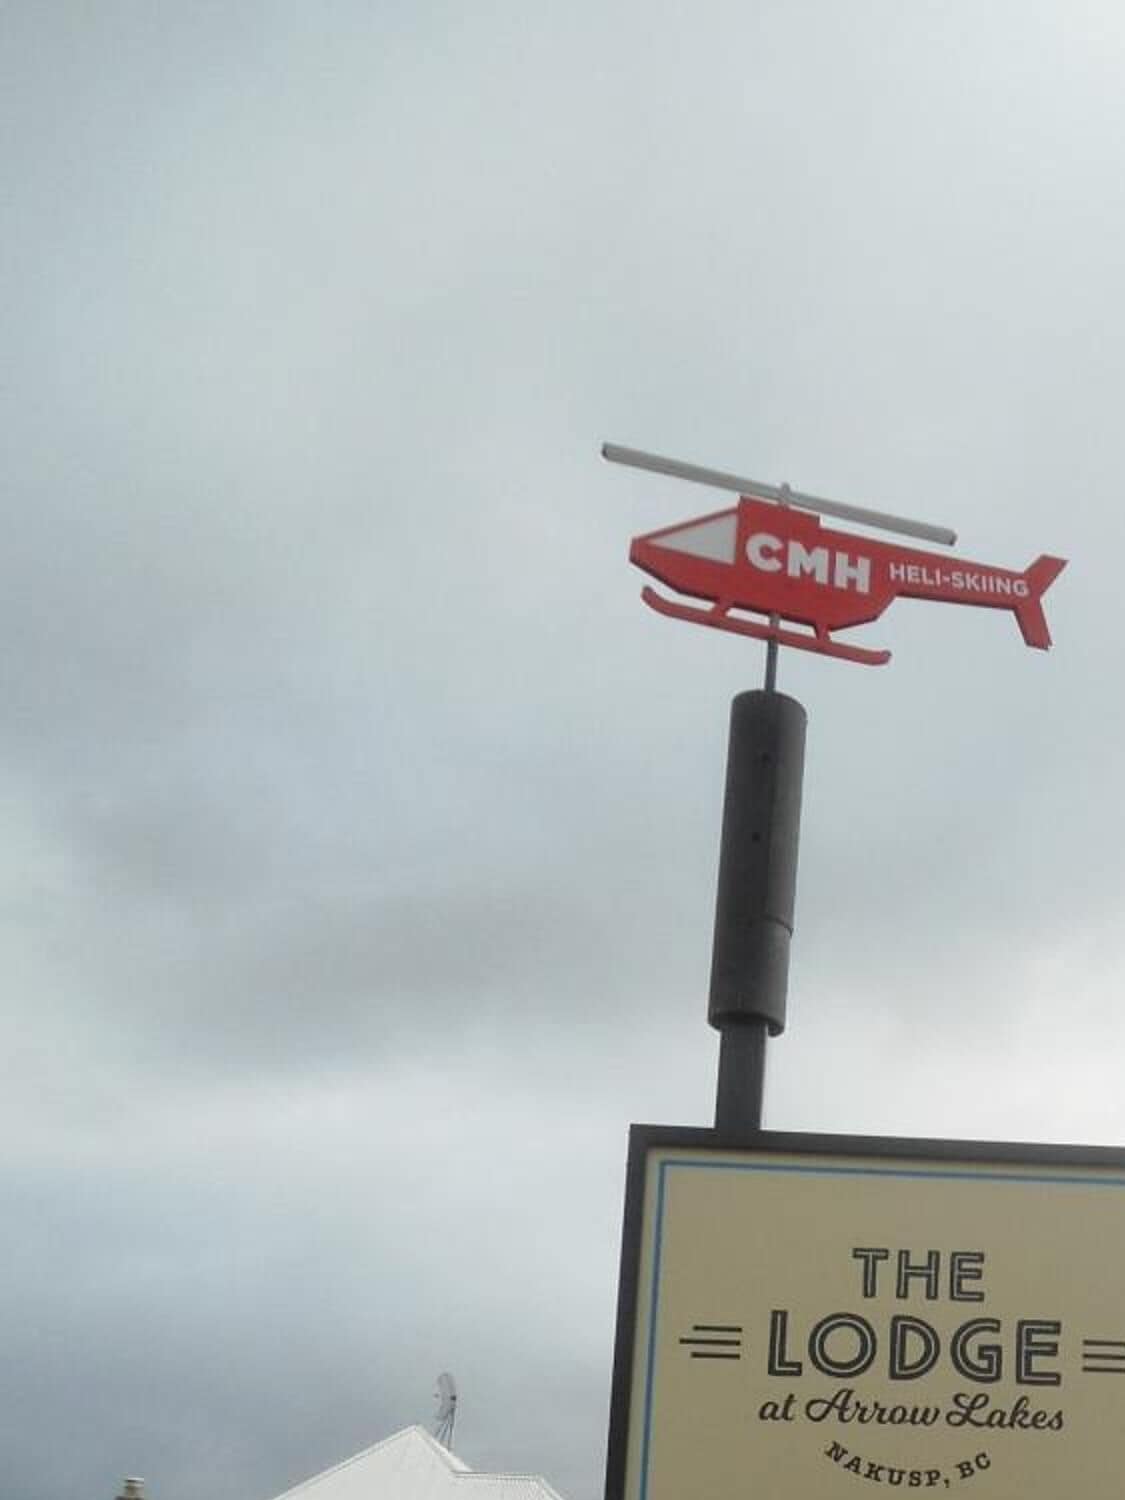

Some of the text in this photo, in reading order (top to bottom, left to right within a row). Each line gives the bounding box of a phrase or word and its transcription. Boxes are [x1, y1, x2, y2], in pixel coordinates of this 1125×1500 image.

[745, 532, 1029, 597] CMH HELI-SKIING
[853, 1247, 985, 1302] THE
[767, 1309, 1062, 1386] LODGE
[759, 1388, 1064, 1430] at Arrow Lakes
[823, 1440, 992, 1489] NAKUSP, BC
